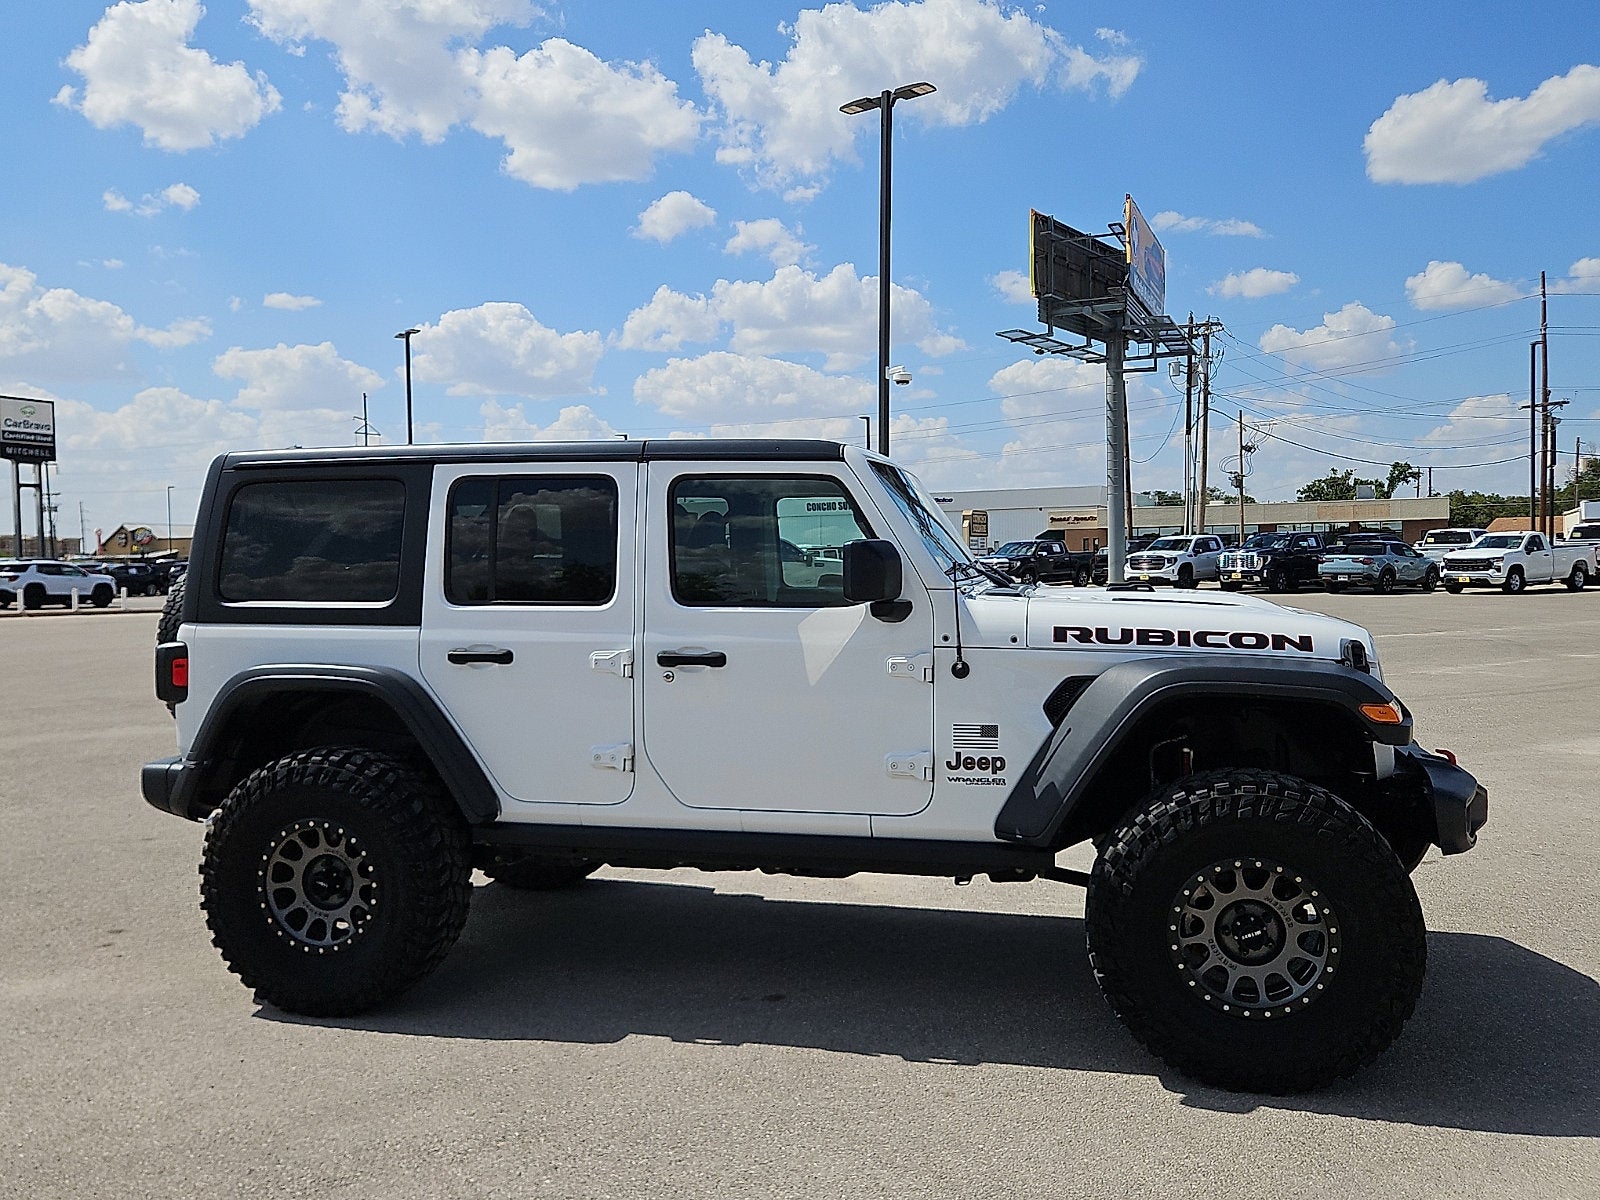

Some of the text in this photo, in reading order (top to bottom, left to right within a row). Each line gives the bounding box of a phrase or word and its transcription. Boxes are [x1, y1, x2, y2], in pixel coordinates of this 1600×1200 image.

[4, 417, 51, 430] CarBravo
[6, 446, 51, 457] MITCHELL
[806, 501, 837, 511] CONCHO
[1053, 625, 1314, 652] RUBICON
[946, 751, 1006, 775] Jeep
[947, 776, 1006, 784] WRANGLER
